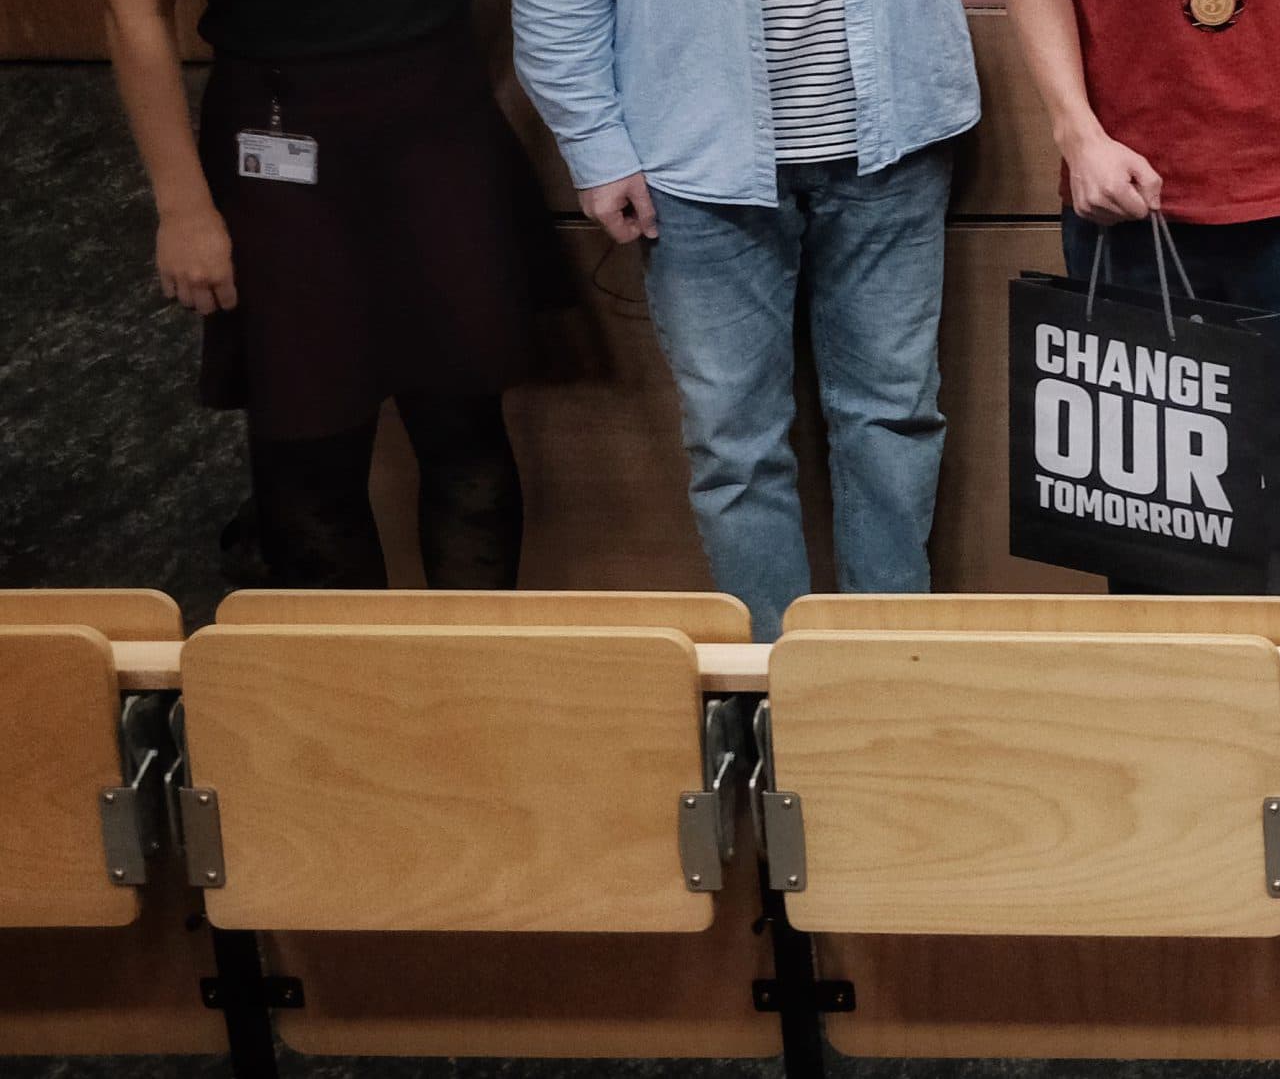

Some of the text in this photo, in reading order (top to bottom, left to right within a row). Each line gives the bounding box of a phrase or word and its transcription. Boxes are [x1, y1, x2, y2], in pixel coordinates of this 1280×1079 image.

[1035, 323, 1231, 414] CHANGE
[1035, 378, 1233, 513] OUR
[1035, 474, 1234, 548] TOMORROW
